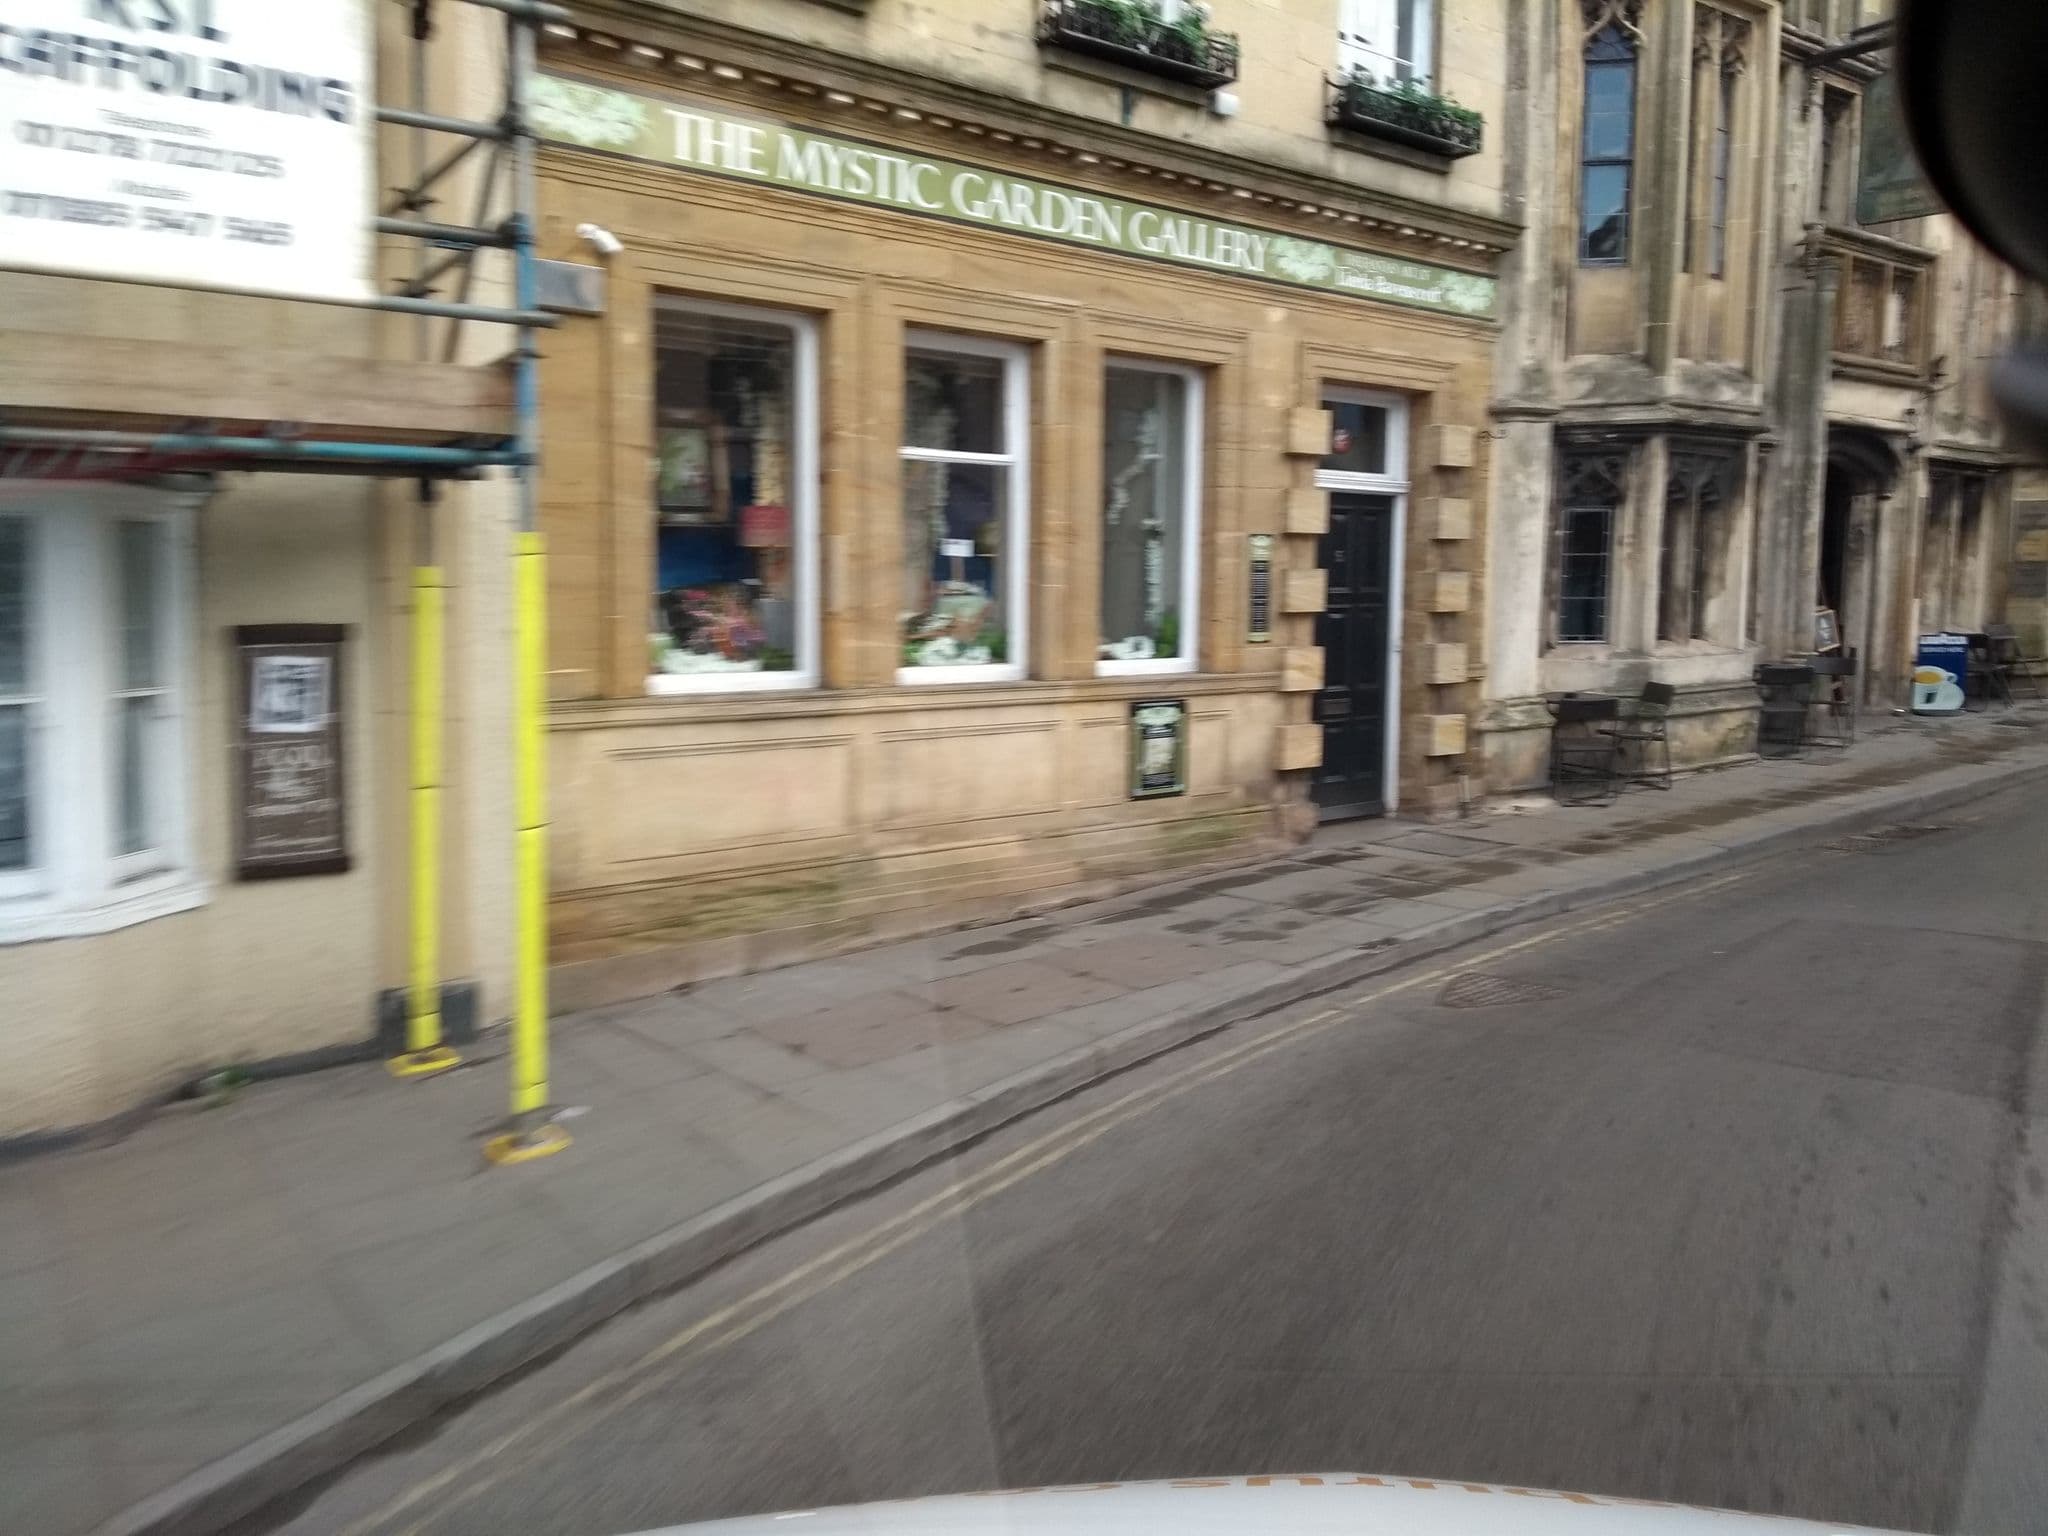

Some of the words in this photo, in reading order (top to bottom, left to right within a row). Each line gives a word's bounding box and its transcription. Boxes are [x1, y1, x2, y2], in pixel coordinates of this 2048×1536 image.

[663, 107, 768, 175] THE
[775, 133, 943, 209] MYSTIC
[950, 172, 1122, 244] GARDEN
[1130, 210, 1272, 273] GALLERY
